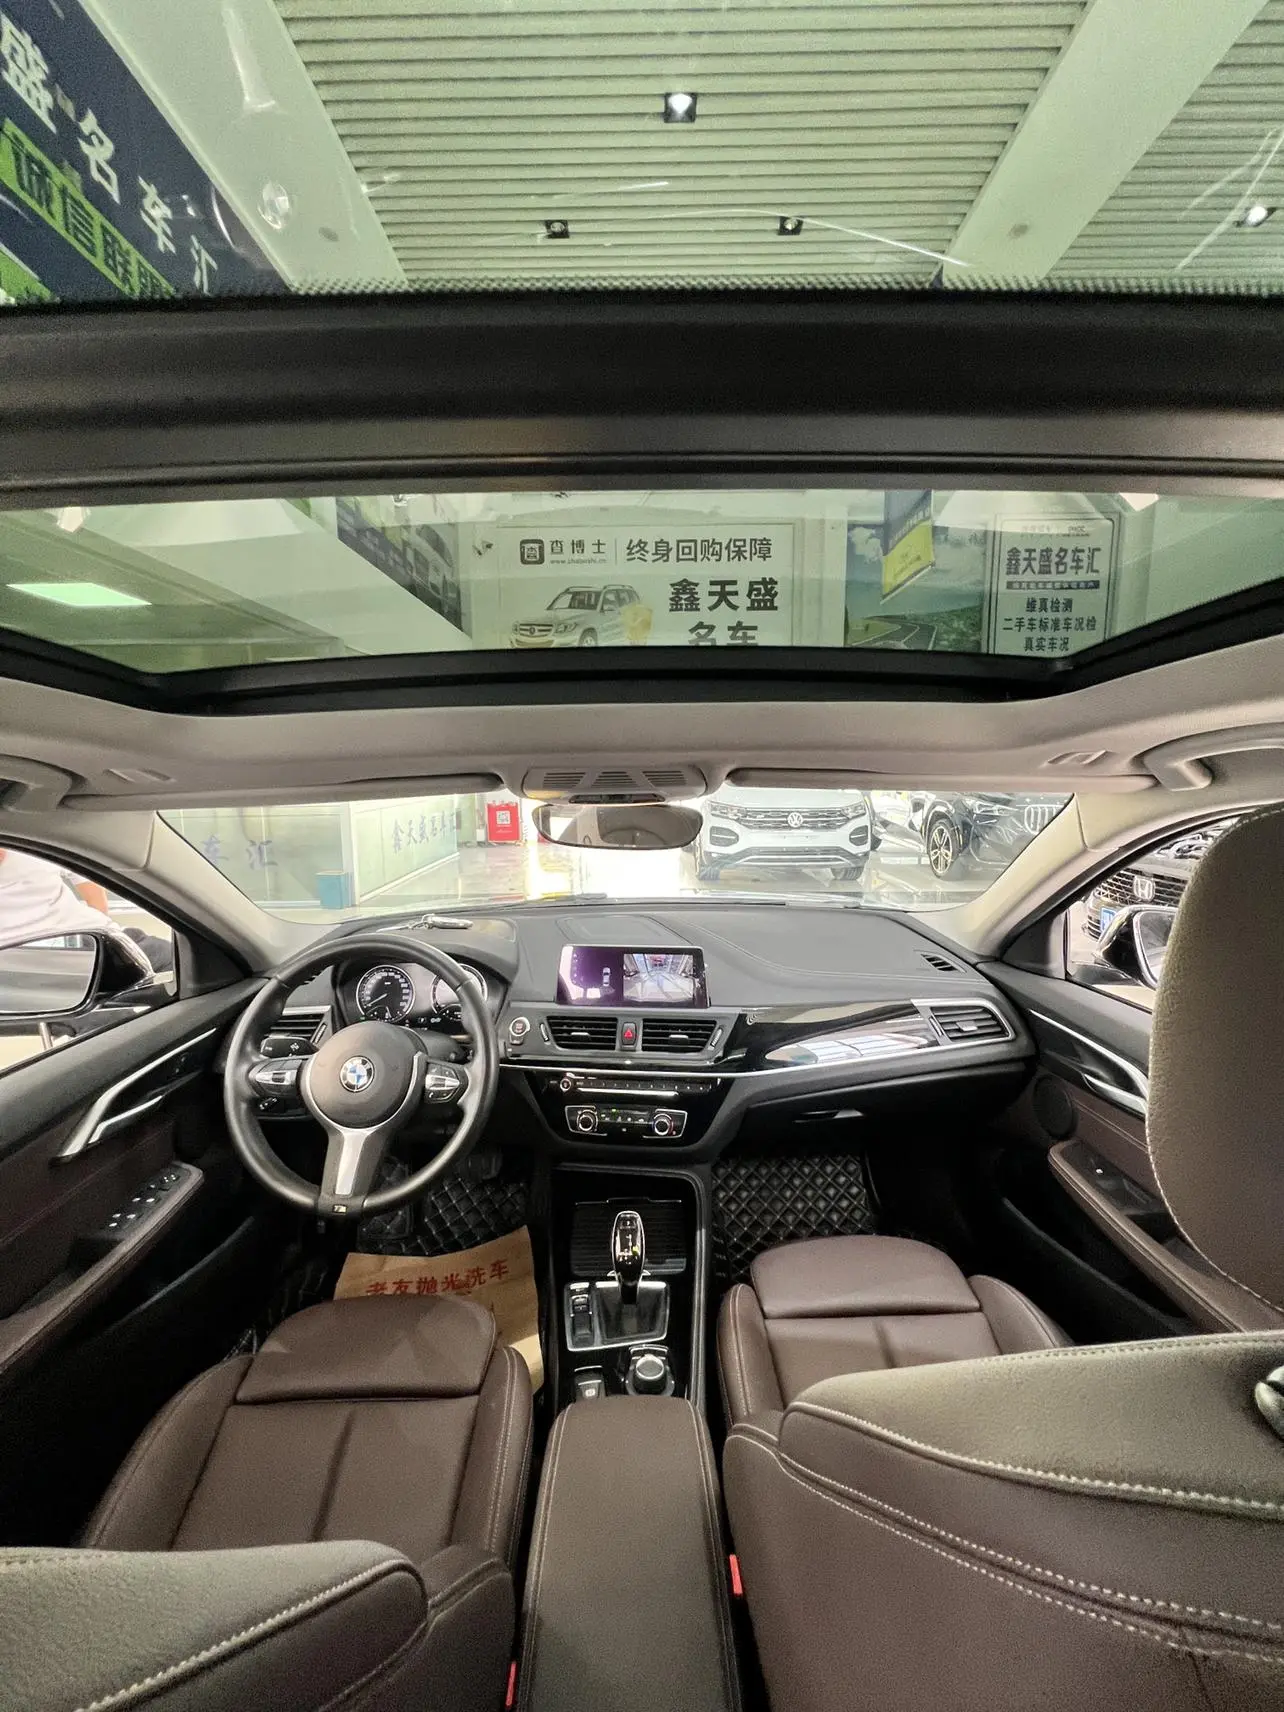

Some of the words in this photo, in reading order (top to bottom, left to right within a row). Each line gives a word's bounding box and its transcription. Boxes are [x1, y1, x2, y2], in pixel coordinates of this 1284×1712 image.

[626, 537, 773, 563] 终身回购保障
[1005, 546, 1101, 576] 鑫天盛名车汇
[668, 577, 778, 612] 鑫天盛
[688, 620, 759, 646] 名车
[1002, 616, 1097, 632] 二手车标准车况检
[1024, 637, 1070, 652] 真实车况
